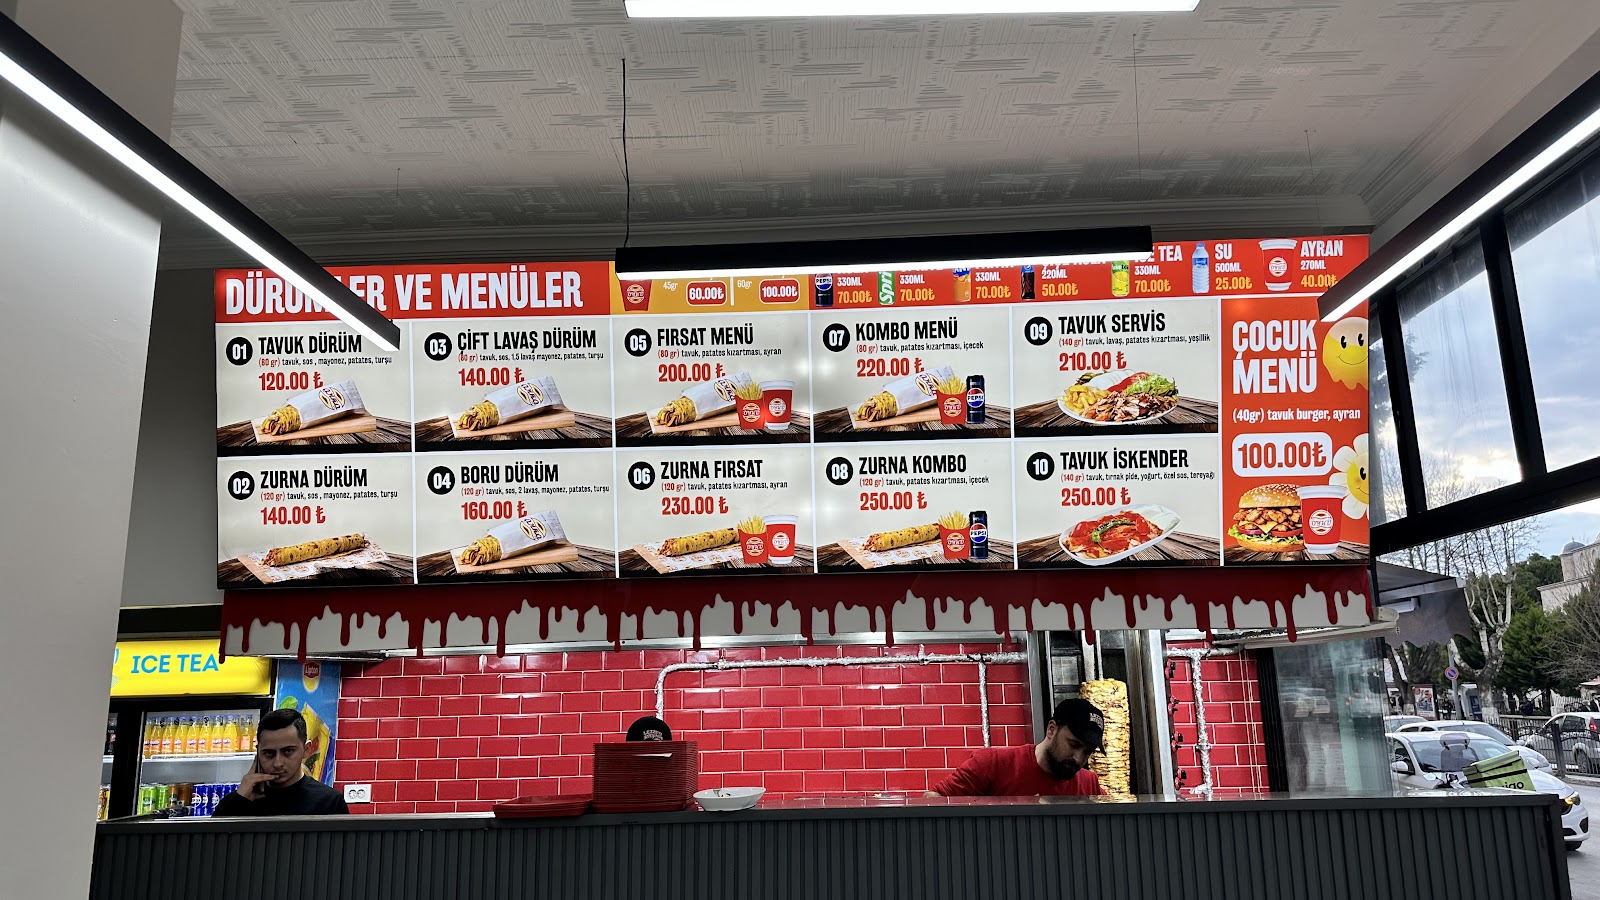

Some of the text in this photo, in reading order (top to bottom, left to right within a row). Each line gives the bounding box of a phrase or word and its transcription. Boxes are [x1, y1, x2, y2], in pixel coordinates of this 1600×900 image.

[1158, 245, 1182, 262] TEA
[1215, 243, 1232, 260] SU
[1300, 240, 1343, 257] AYRAN
[1135, 266, 1161, 275] 330ML
[1215, 263, 1241, 273] 500ML
[1301, 260, 1326, 270] 270ML
[837, 277, 862, 286] 330ML
[900, 275, 925, 284] 330ML
[975, 272, 1001, 281] 330ML
[1042, 269, 1067, 279] 220ML
[394, 274, 432, 311] VE
[442, 265, 583, 309] MENÜLER
[663, 282, 678, 290] 45gr
[737, 280, 752, 288] 60gr
[856, 317, 958, 341] KOMBO MENÜ
[1059, 310, 1165, 334] TAVUK SERVİS
[658, 323, 753, 346] FIRSAT MENÜ
[828, 330, 844, 346] 07
[1030, 323, 1047, 340] 09
[1232, 320, 1317, 359] ÇOCUK
[258, 332, 362, 355] TAVUK DÜRÜM
[430, 339, 447, 355] 03
[458, 327, 596, 355] ÇİFT LAVAŞ DÜRÜM
[630, 335, 646, 351] 05
[868, 344, 878, 353] gr)
[880, 344, 899, 352] tavuk,
[901, 344, 924, 352] patates
[964, 341, 984, 350] içecek
[1074, 337, 1083, 347] gr)
[1085, 337, 1105, 345] tavuk,
[1126, 336, 1149, 345] patates
[232, 344, 247, 360] 01
[670, 350, 679, 359] gr)
[681, 350, 700, 358] tavuk,
[702, 350, 725, 358] patates
[763, 348, 782, 356] ayran
[282, 358, 301, 366] tavuk,
[857, 358, 910, 377] 220.00
[1060, 352, 1111, 371] 210.00
[259, 372, 308, 390] 120.00
[458, 368, 509, 386] 140.00
[658, 363, 710, 382] 200.00
[1233, 351, 1317, 394] MENÜ
[1233, 408, 1360, 423] (40gr) tavuk burger, ayran
[859, 454, 966, 474] ZURNA KOMBO
[1060, 447, 1188, 469] TAVUK İSKENDER
[461, 461, 558, 484] BORU DÜRÜM
[661, 460, 763, 479] ZURNA FIRSAT
[831, 464, 848, 479] 08
[1033, 459, 1048, 475] 10
[260, 466, 367, 489] ZURNA DÜRÜM
[433, 473, 451, 489] 04
[633, 468, 650, 484] 06
[875, 478, 884, 486] gr)
[907, 478, 930, 486] patates
[969, 476, 989, 484] içecek
[1075, 473, 1084, 482] gr)
[1086, 473, 1104, 481] tavuk,
[233, 478, 250, 494] 02
[676, 483, 686, 492] gr)
[708, 482, 731, 491] patates
[860, 492, 912, 510] 250.00
[1062, 488, 1115, 506] 250.00
[461, 501, 512, 520] 160.00
[662, 497, 714, 515] 230.00
[261, 506, 311, 525] 140.00
[131, 655, 171, 673] ICE
[177, 654, 219, 672] TEA
